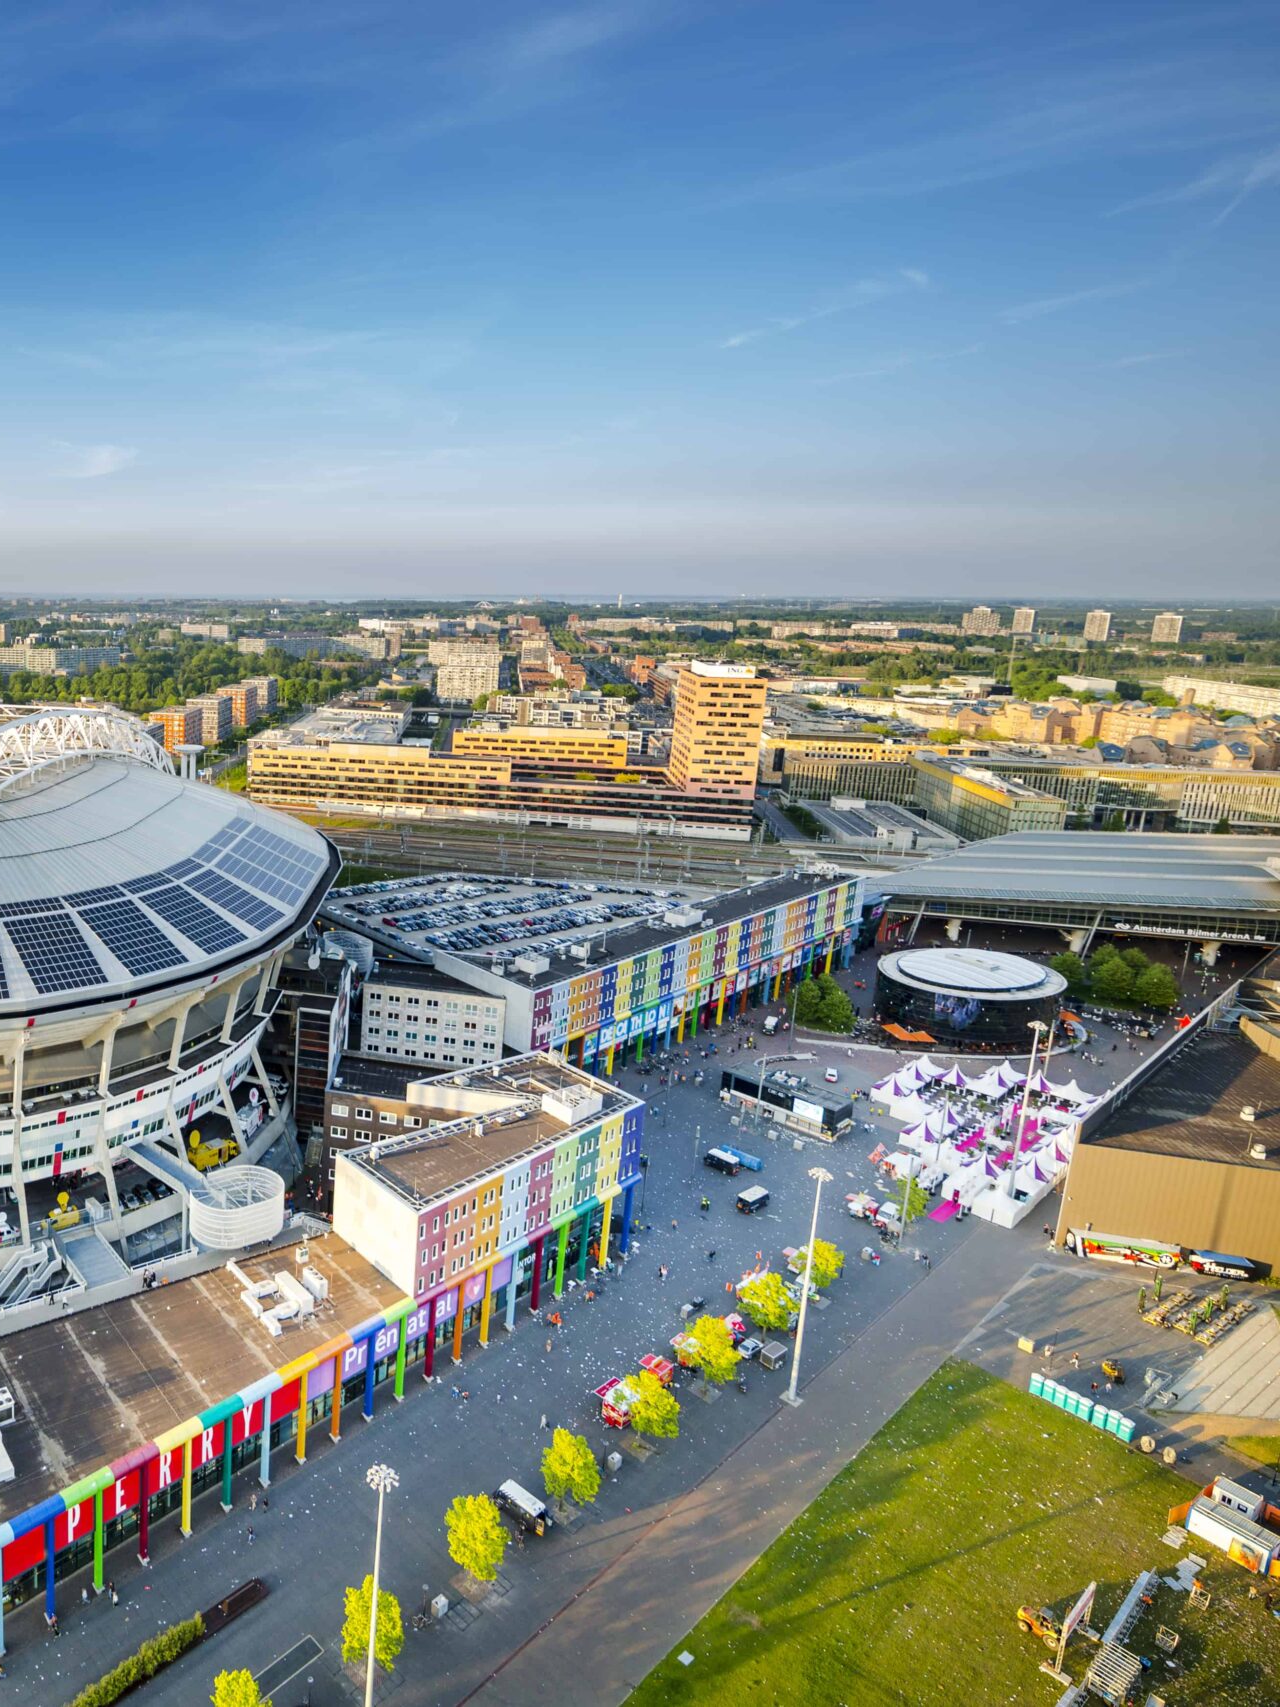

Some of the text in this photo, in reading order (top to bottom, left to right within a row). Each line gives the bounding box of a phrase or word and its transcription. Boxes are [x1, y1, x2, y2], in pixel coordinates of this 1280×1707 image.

[1133, 924, 1250, 940] Amsterdam Bijlmer ArenA
[345, 1293, 452, 1372] Prénatal
[67, 1403, 254, 1544] PERRY
